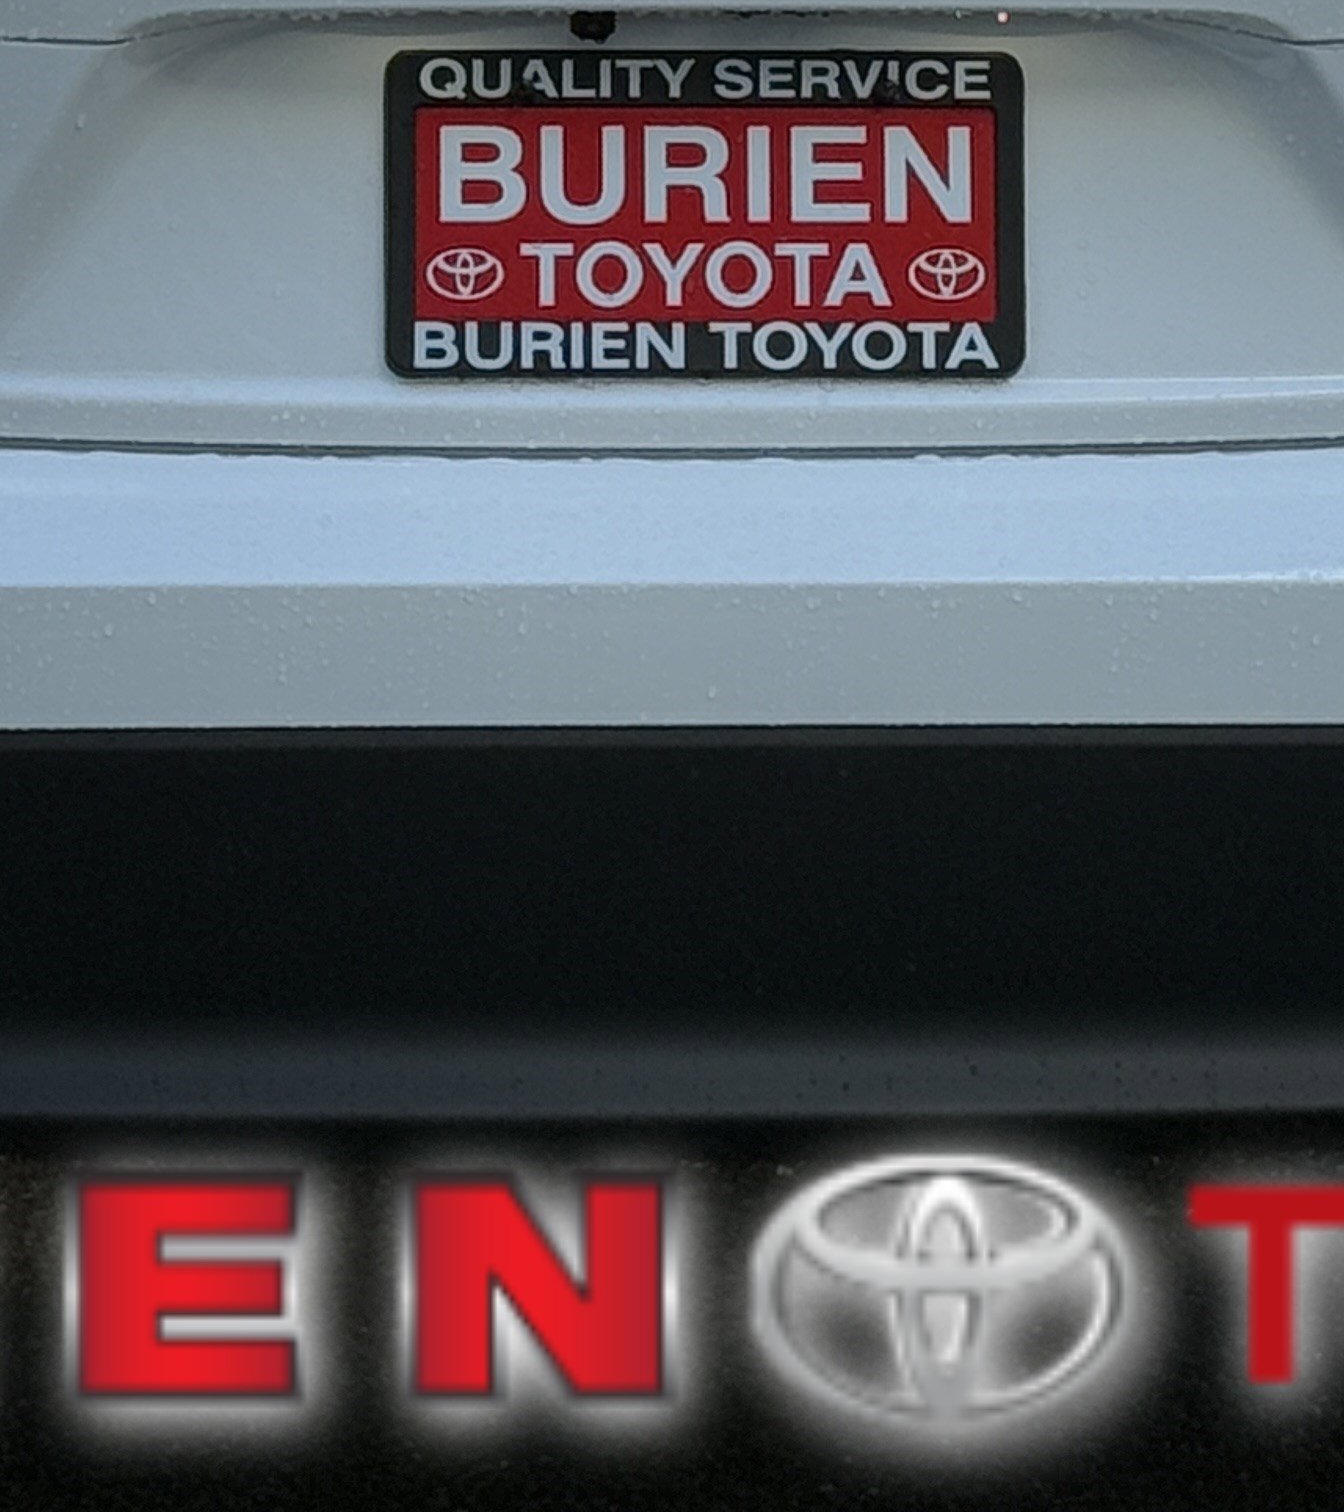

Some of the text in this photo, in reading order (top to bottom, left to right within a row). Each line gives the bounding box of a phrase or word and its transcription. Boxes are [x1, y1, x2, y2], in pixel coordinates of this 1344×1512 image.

[419, 58, 992, 100] QUALITY SERVICE
[438, 124, 973, 224] BURIEN
[520, 240, 892, 308] TOYOTA
[413, 321, 999, 370] BURIEN TOYOTA
